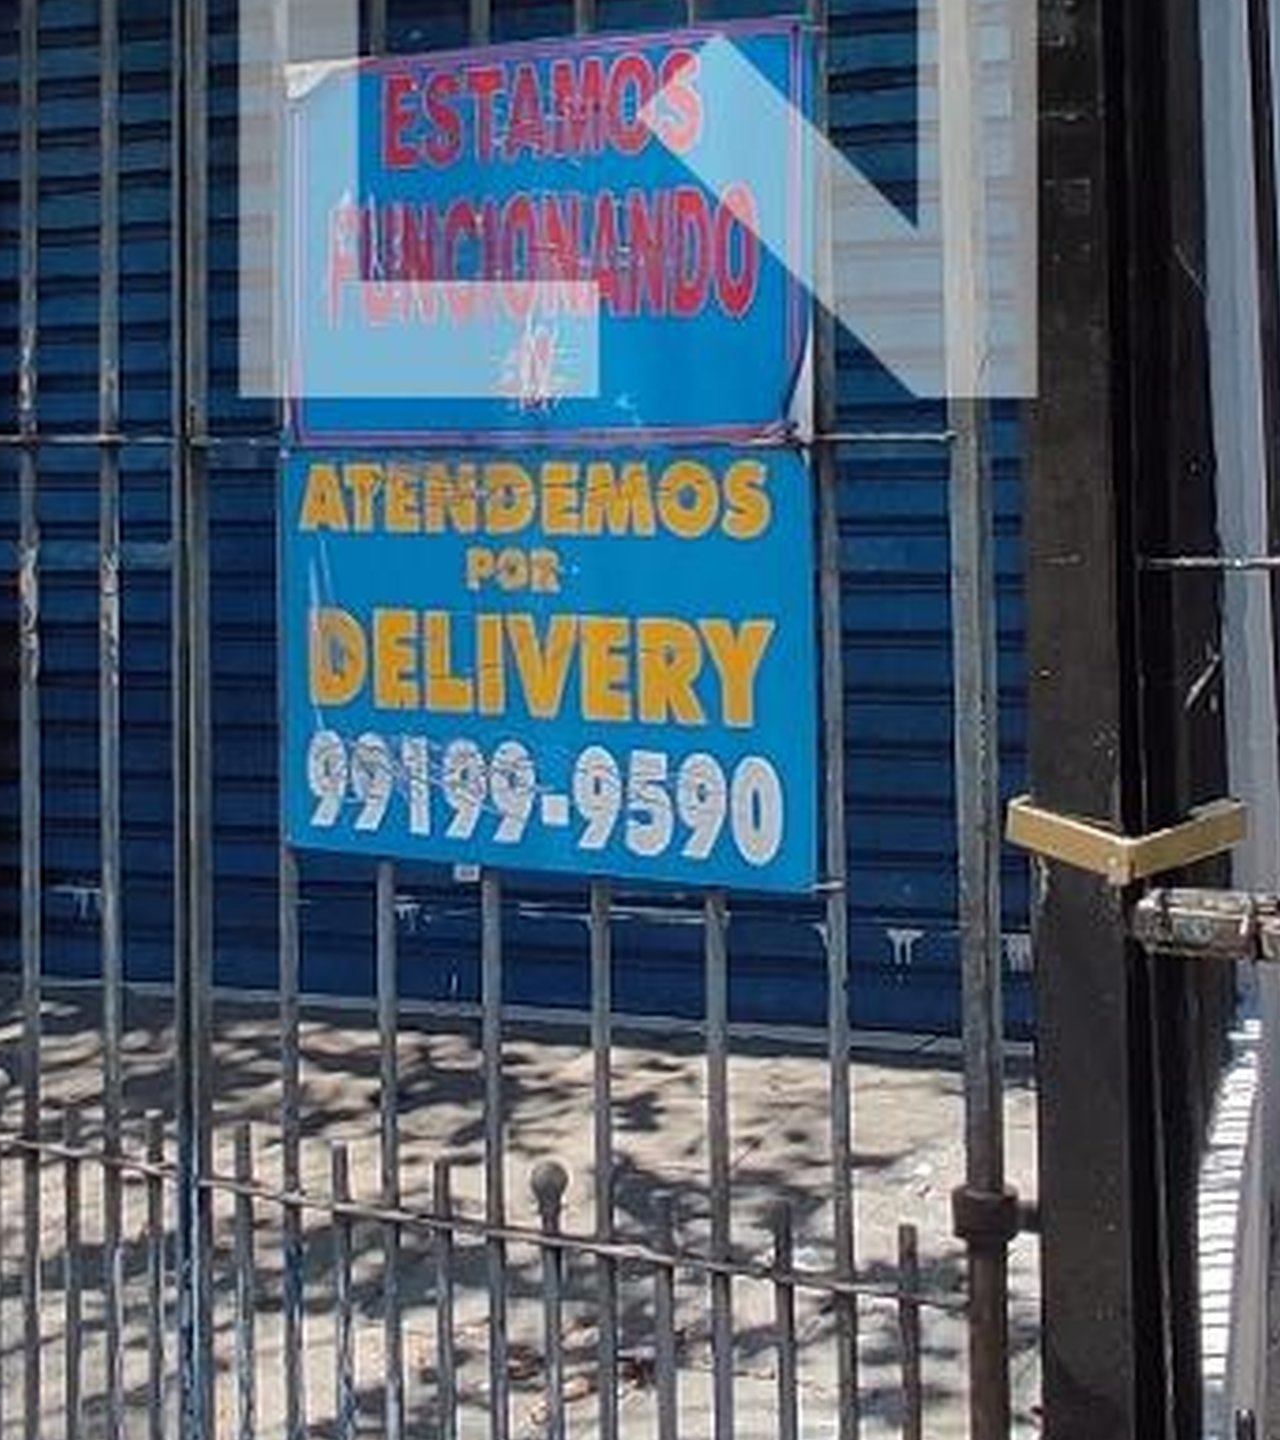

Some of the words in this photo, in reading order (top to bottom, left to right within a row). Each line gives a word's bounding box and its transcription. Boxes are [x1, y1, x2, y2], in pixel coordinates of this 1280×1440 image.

[383, 48, 703, 170] ESTAMOS
[328, 181, 759, 328] FUNCIONANDO
[298, 459, 772, 539] ATENDEMOS
[466, 545, 561, 594] POR
[308, 605, 776, 728] DELIVERY
[308, 729, 784, 866] 99199-9590
